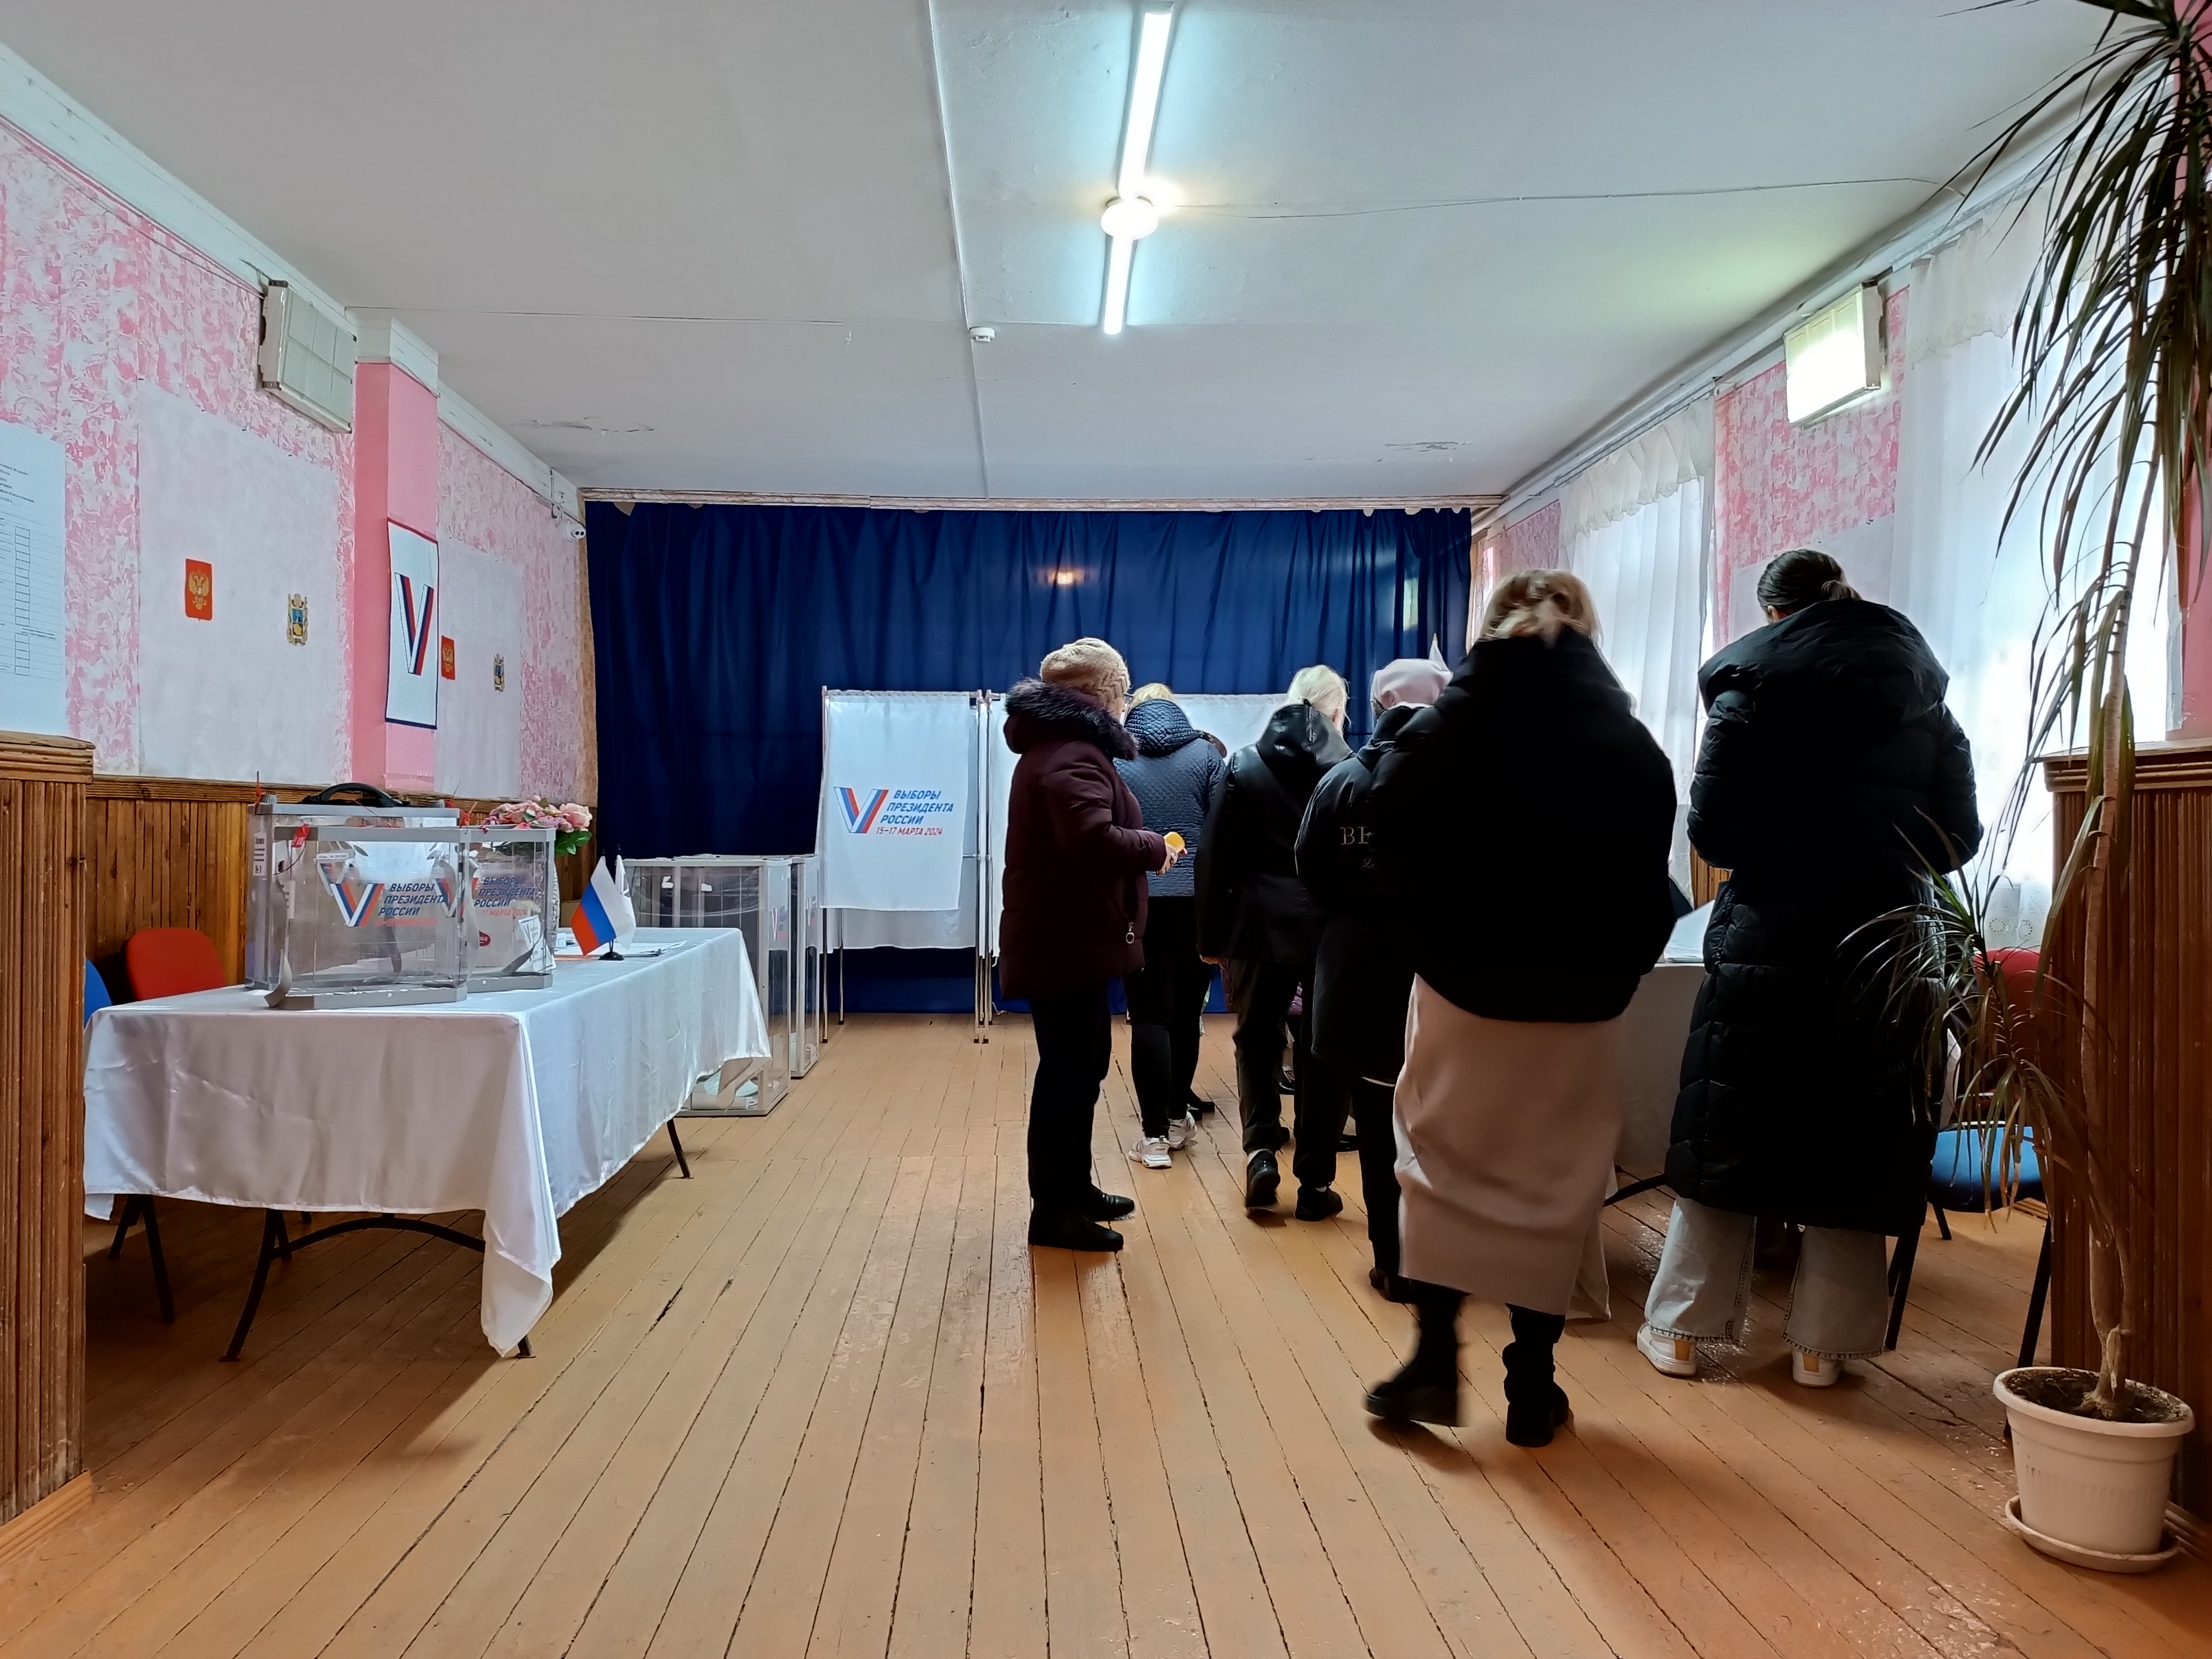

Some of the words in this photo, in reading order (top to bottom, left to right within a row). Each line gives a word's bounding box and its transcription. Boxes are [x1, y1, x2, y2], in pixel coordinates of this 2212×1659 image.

[893, 789, 942, 800] ВЫБОРЫ
[886, 802, 954, 814] ПРЕЗИДЕНТА
[880, 814, 924, 825] РОССИИ
[897, 827, 924, 836] МАРТА
[924, 827, 943, 836] 2024
[389, 883, 435, 892] ВЫБОРЫ
[478, 887, 536, 896] ПРЕЗИДЕНТА
[474, 899, 512, 907] РОССИИ
[378, 907, 420, 916] РОССИИ
